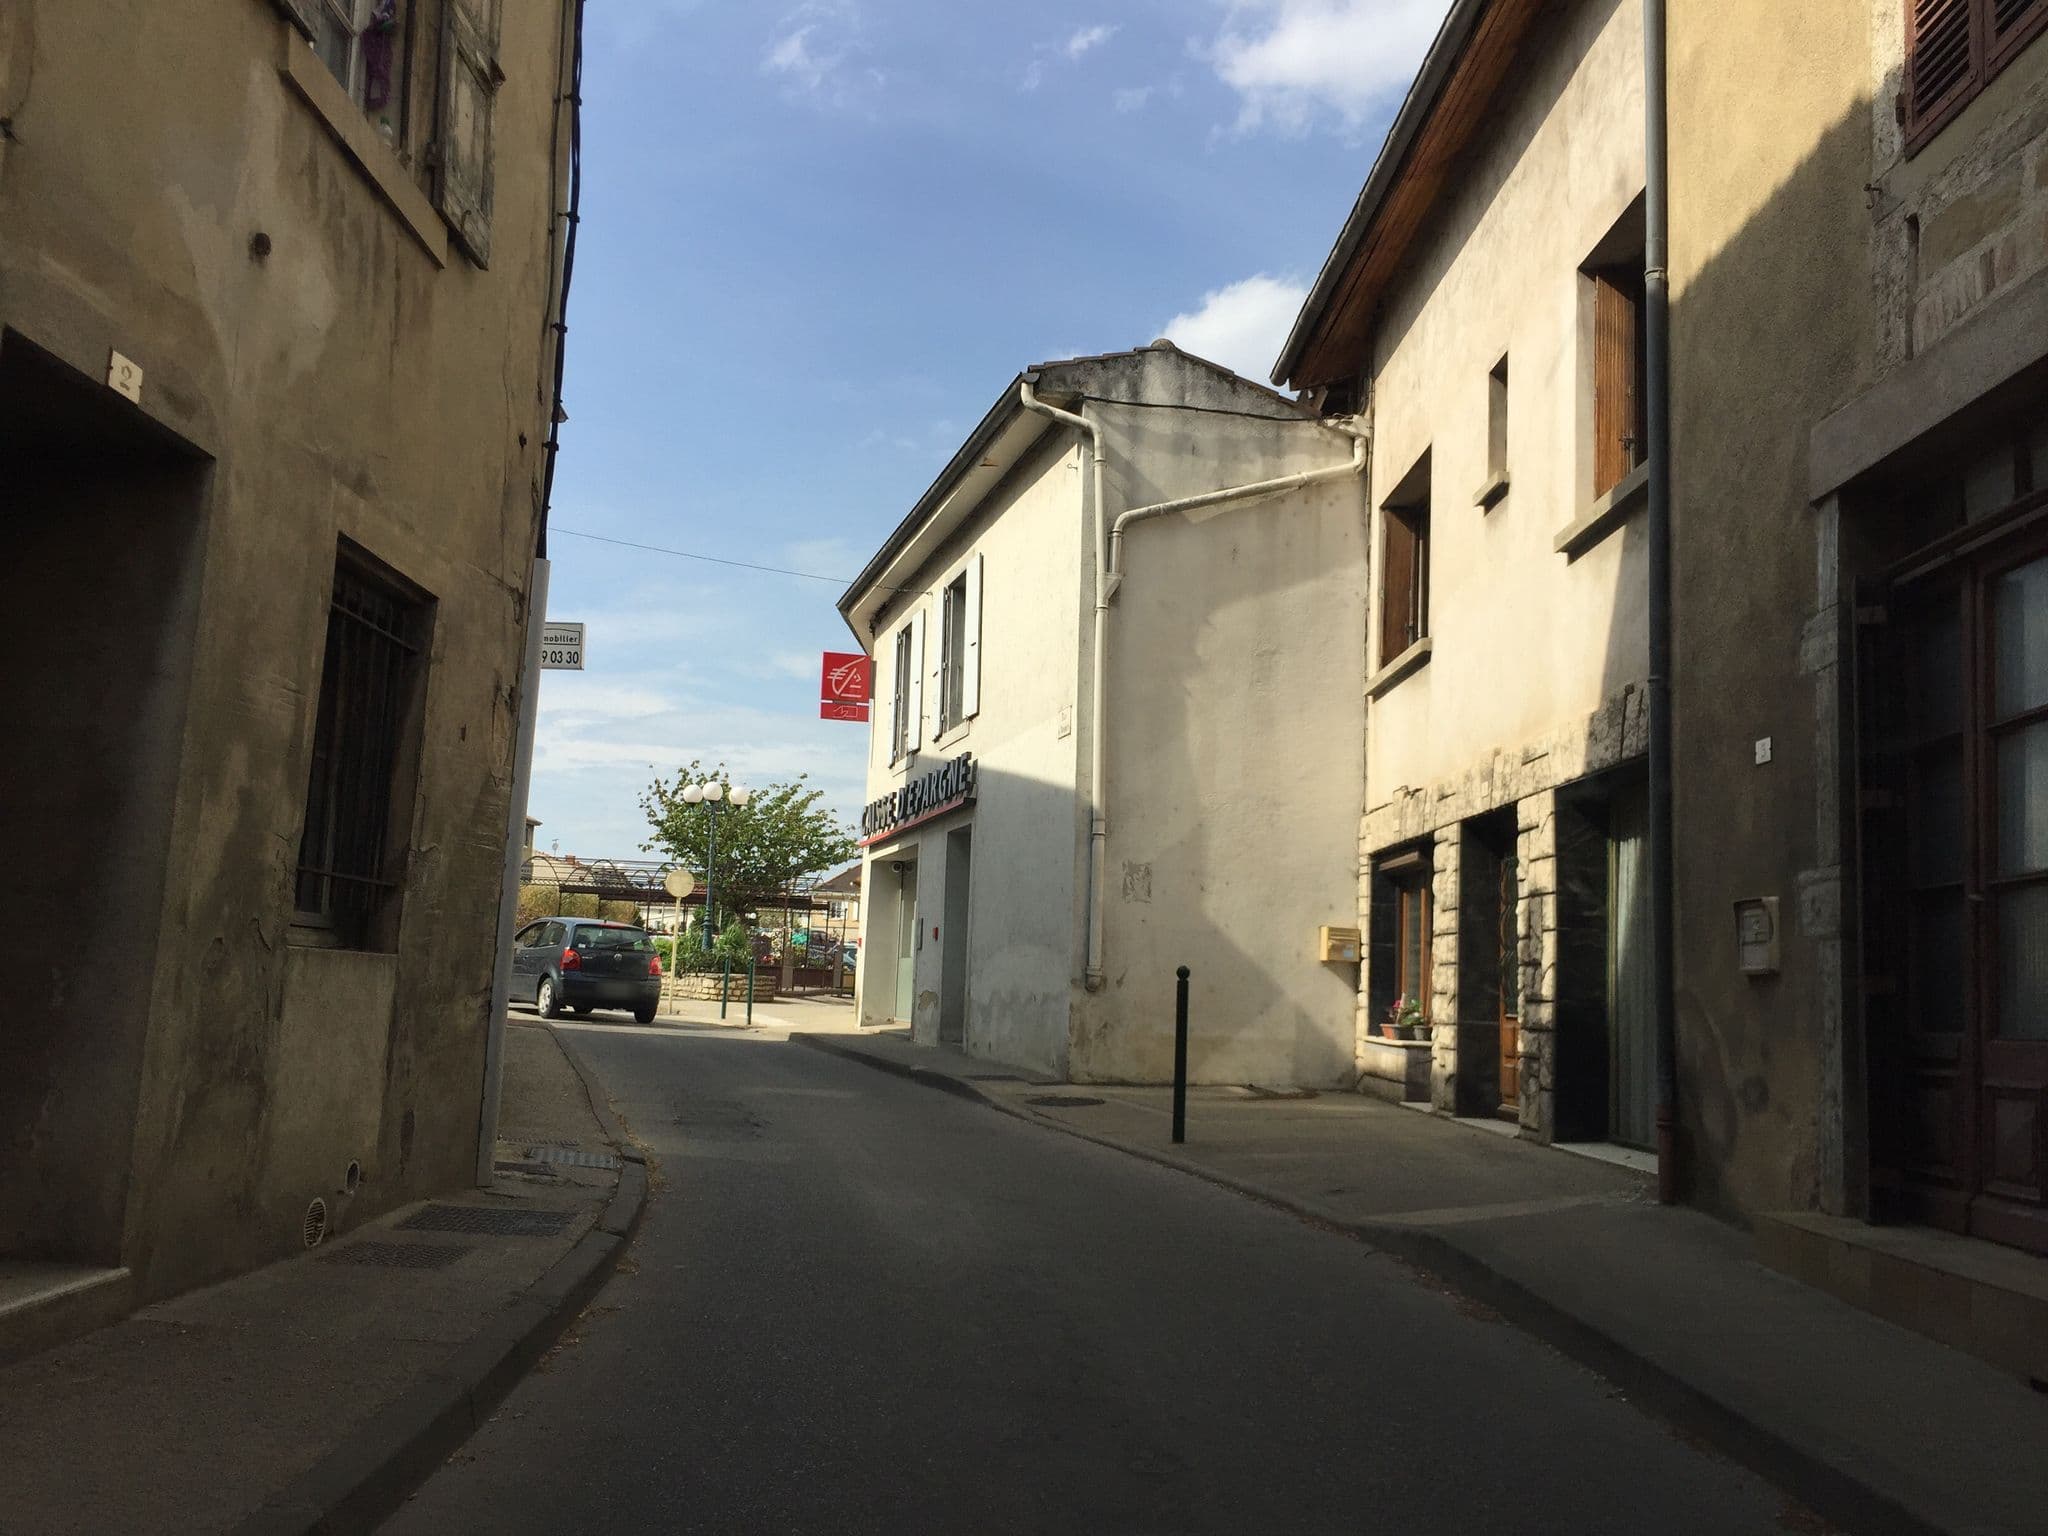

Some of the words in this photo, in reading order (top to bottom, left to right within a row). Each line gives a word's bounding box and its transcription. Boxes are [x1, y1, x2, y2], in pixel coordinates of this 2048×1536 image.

[120, 365, 133, 391] 2
[550, 650, 563, 664] 03
[566, 651, 579, 664] 30
[861, 791, 898, 836] CAISSE
